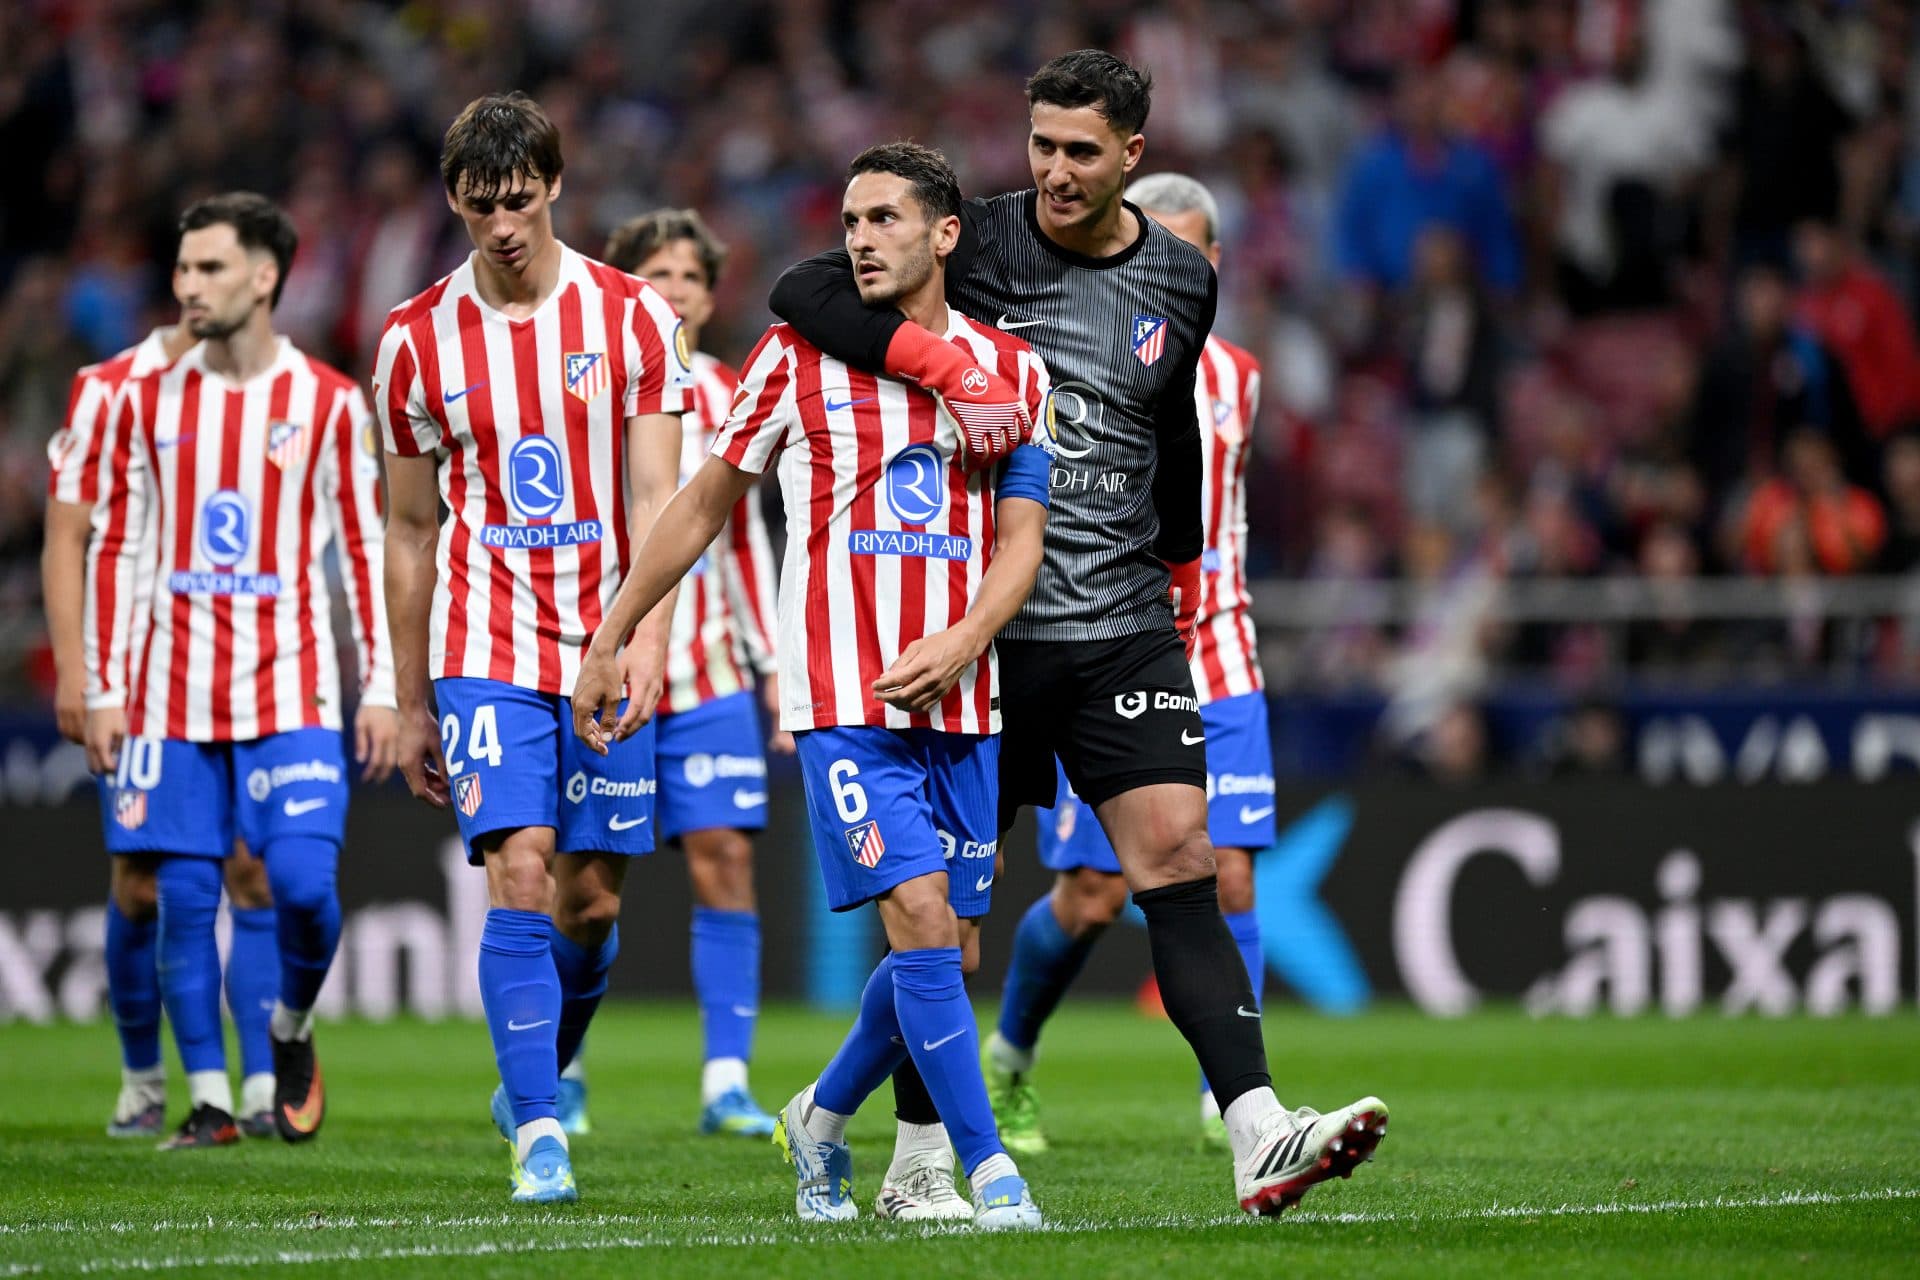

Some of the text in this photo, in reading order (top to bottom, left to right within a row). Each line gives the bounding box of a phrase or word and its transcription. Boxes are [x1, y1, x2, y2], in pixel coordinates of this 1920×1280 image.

[1093, 472, 1127, 493] AIR
[485, 521, 599, 546] RIYADH AIR
[854, 533, 968, 559] RIYADH AIR
[441, 704, 503, 777] 24
[828, 758, 868, 824] 6
[1393, 807, 1920, 1018] Caixa
